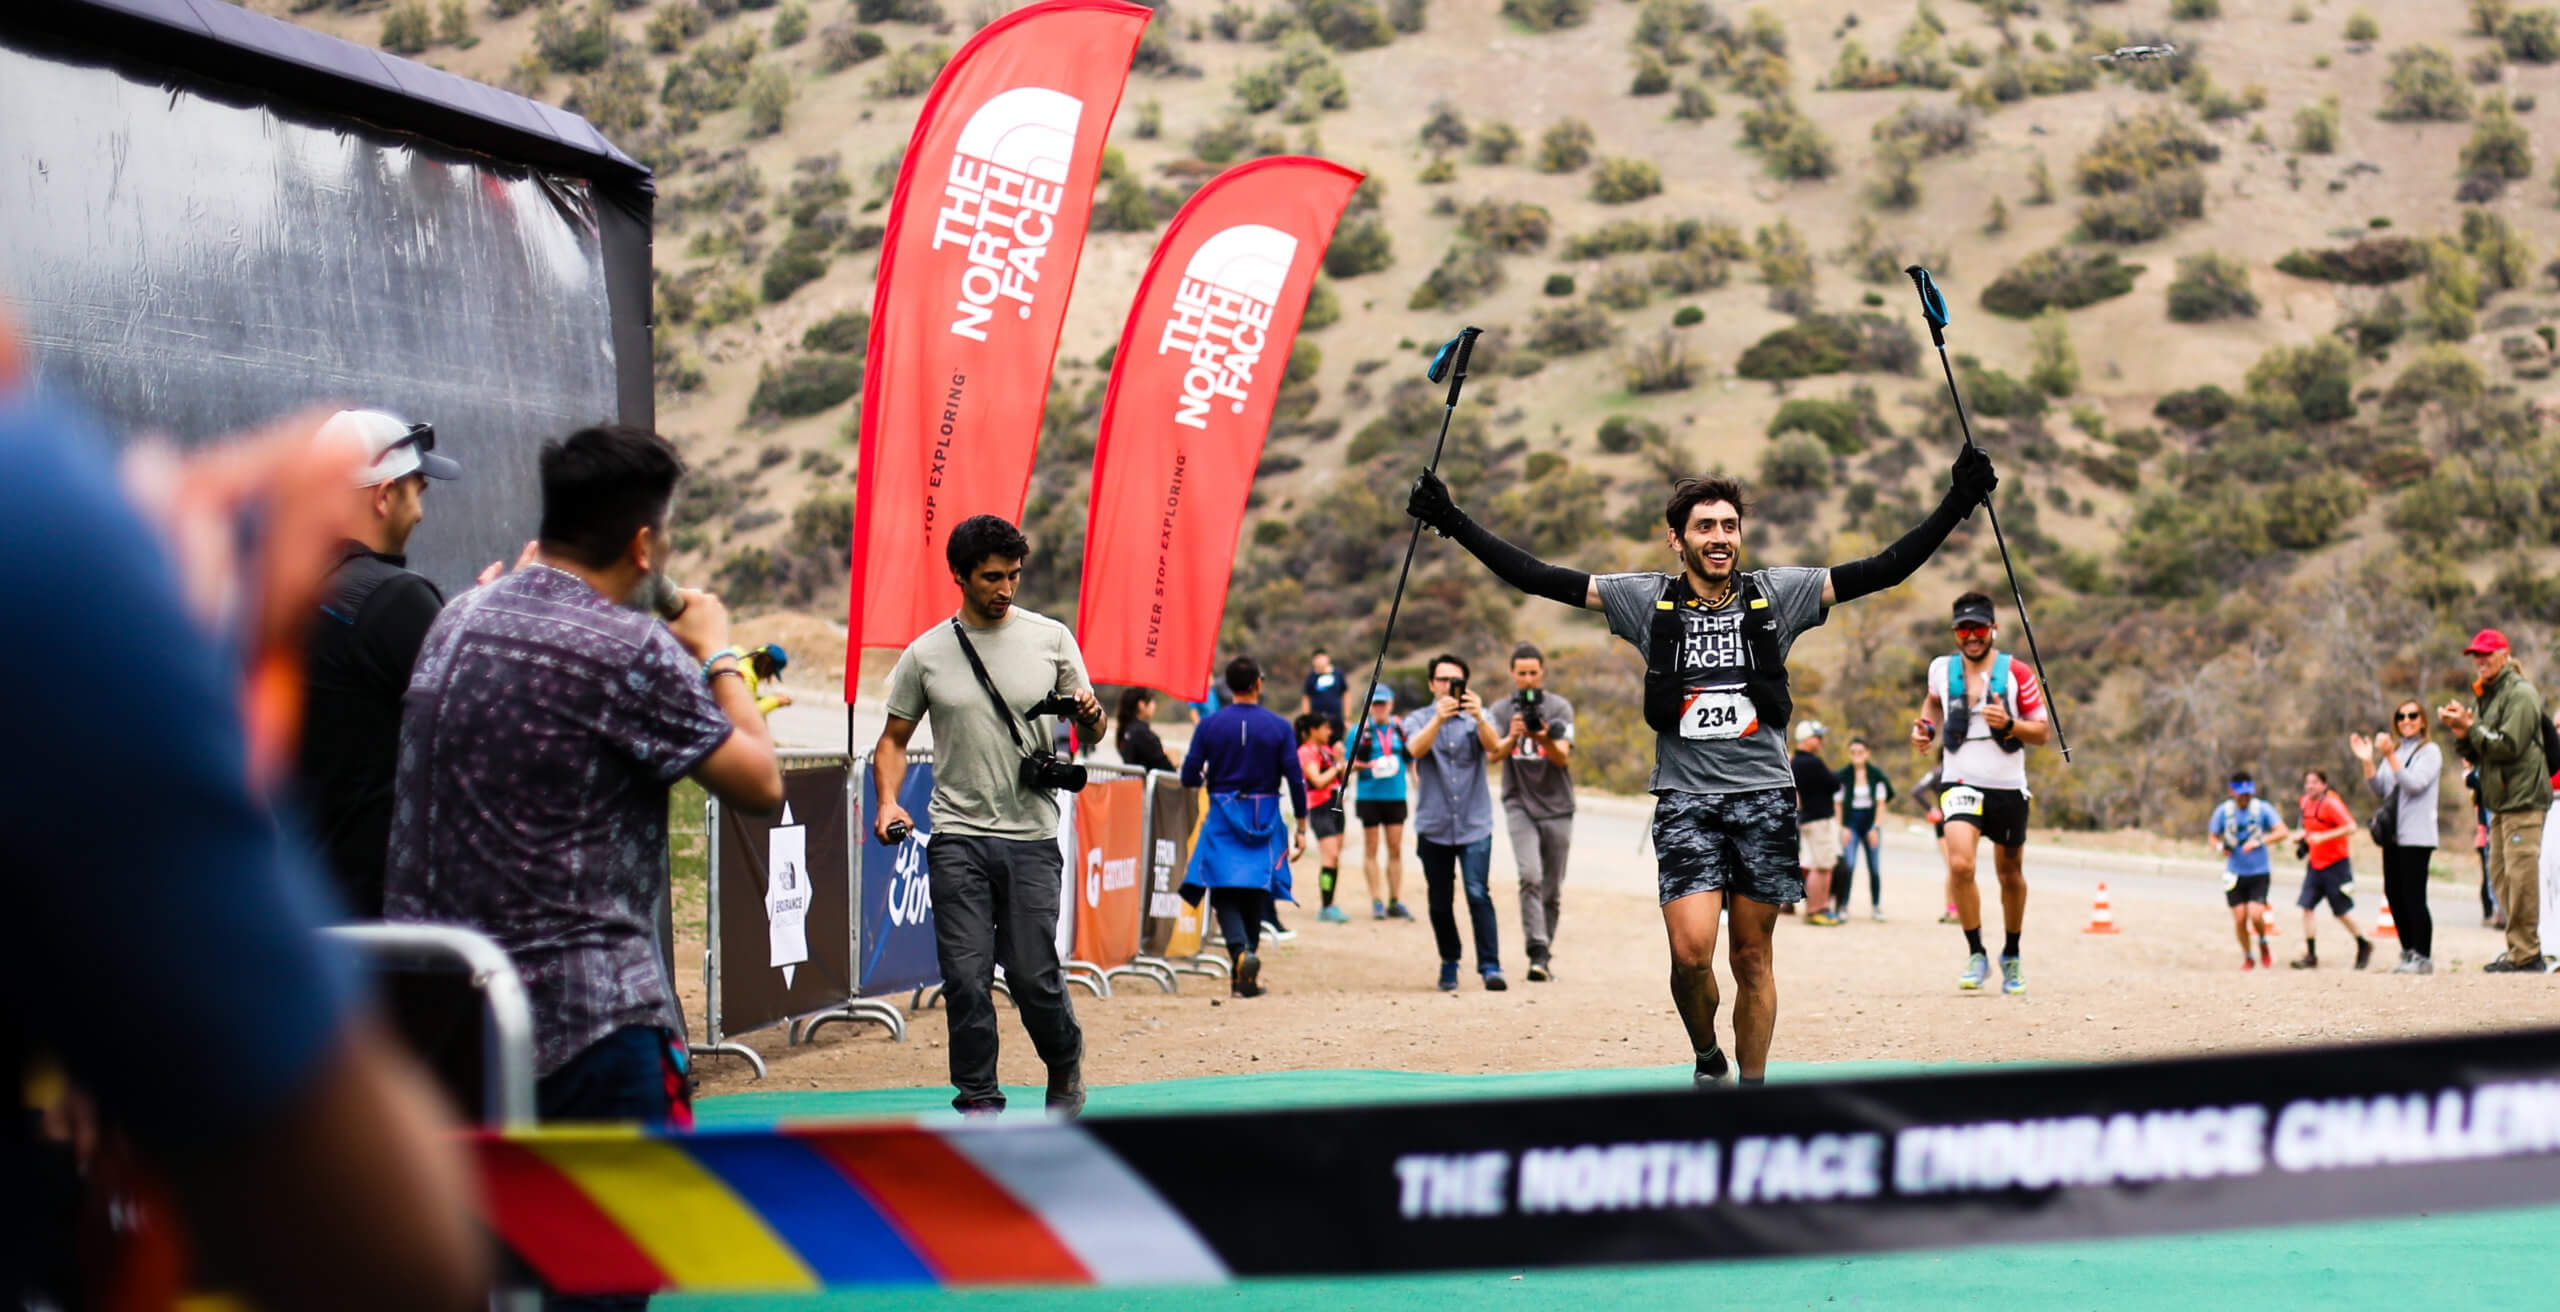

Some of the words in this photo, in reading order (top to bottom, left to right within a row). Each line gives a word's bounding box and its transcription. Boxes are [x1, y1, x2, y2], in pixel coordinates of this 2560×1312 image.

[932, 154, 989, 250] THE
[950, 165, 1026, 342] NORTH
[1000, 176, 1064, 305] FACE
[1158, 277, 1212, 354] THE
[1174, 287, 1245, 429] NORTH
[1215, 298, 1274, 401] FACE
[930, 373, 967, 488] EXPLORING
[1145, 603, 1163, 658] NEVER
[1155, 555, 1167, 597] STOP
[1161, 455, 1187, 551] EXPLORING
[1684, 649, 1735, 668] ACE
[1689, 616, 1733, 633] THE
[1697, 705, 1738, 728] 234
[1395, 1150, 1509, 1217] THE
[1517, 1139, 1721, 1213] NORTH
[1728, 1132, 1882, 1203] FACE
[1893, 1104, 2268, 1193] ENDURANCE
